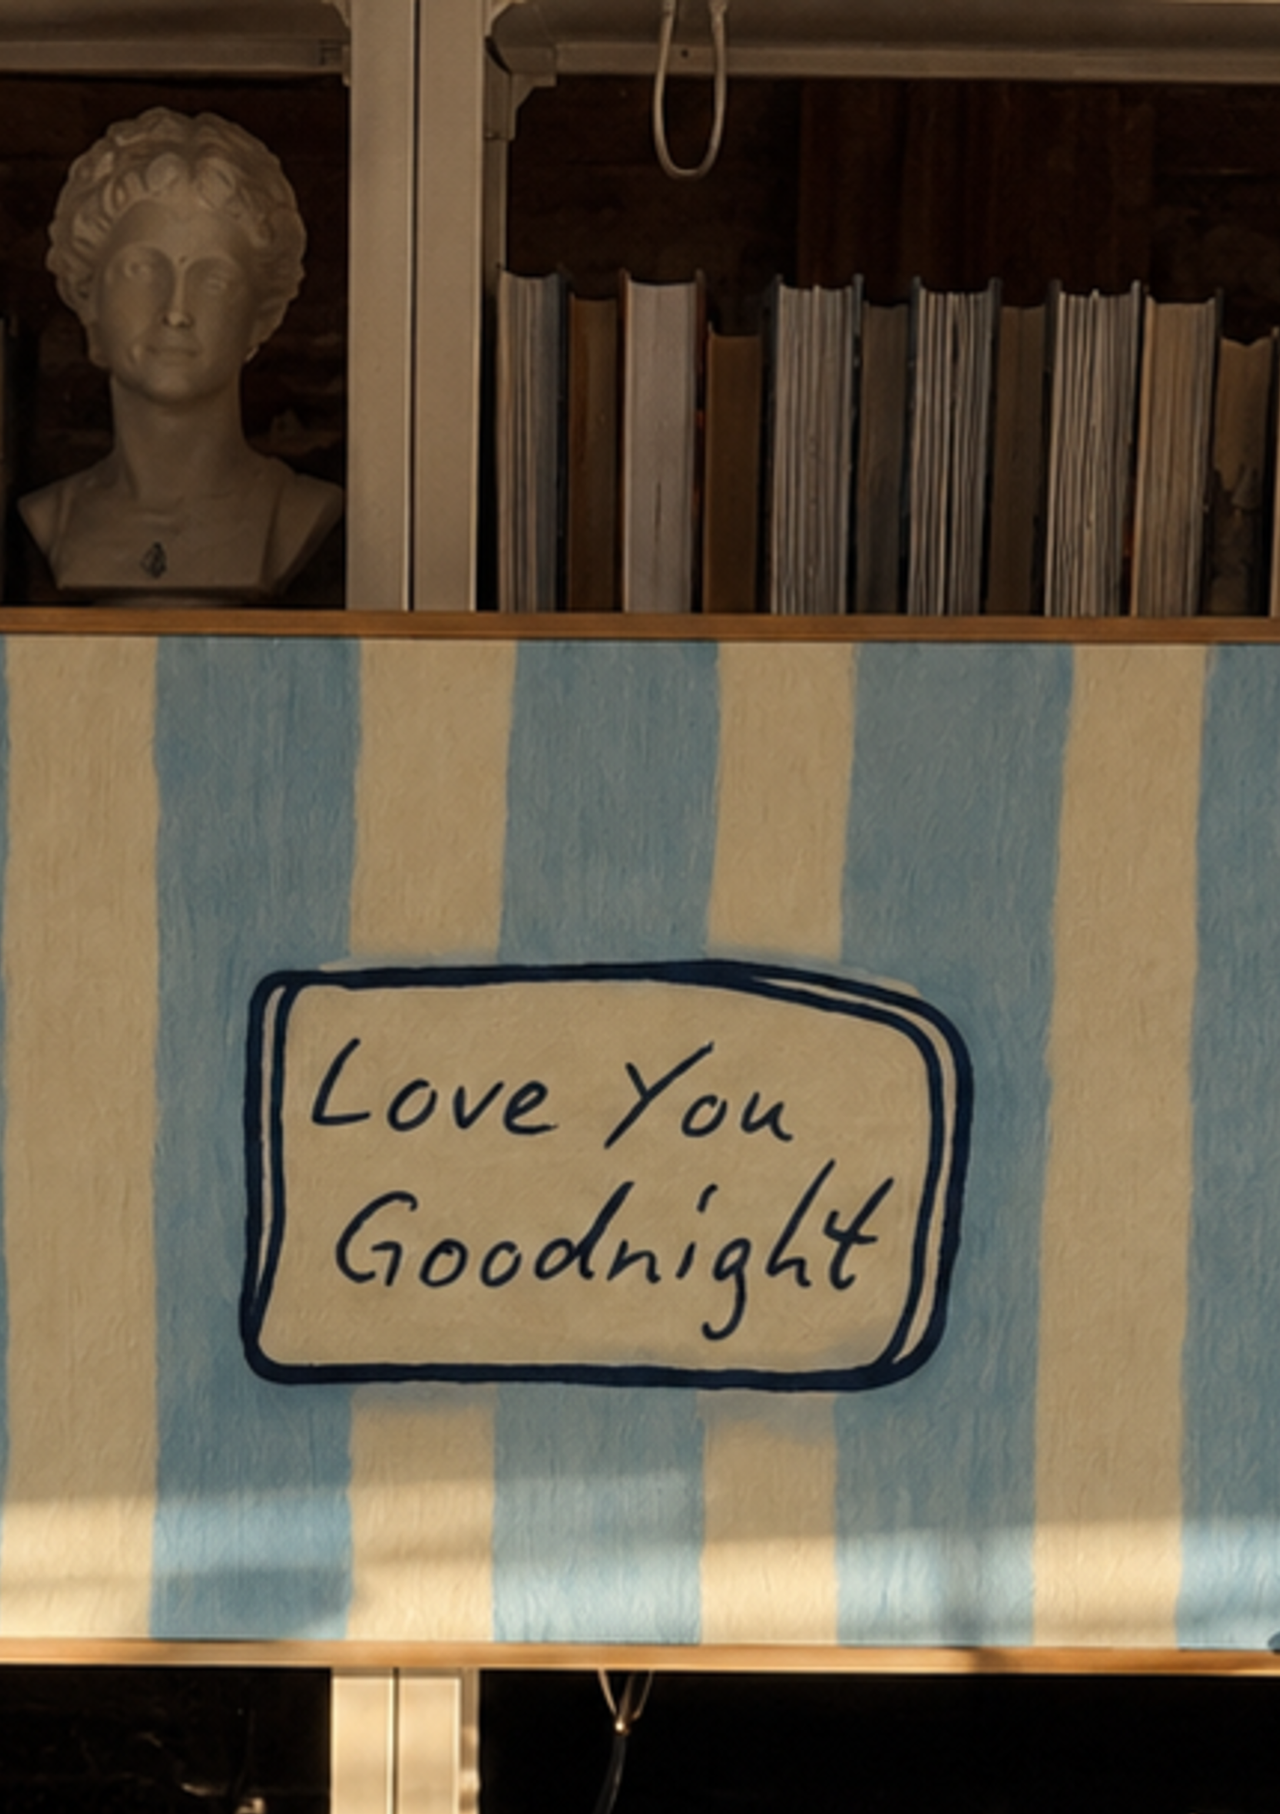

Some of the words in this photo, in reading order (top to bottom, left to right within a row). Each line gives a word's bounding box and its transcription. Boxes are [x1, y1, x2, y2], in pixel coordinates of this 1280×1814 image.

[310, 1036, 559, 1134] Love
[604, 1041, 795, 1150] You
[335, 1158, 895, 1341] Goodnight
